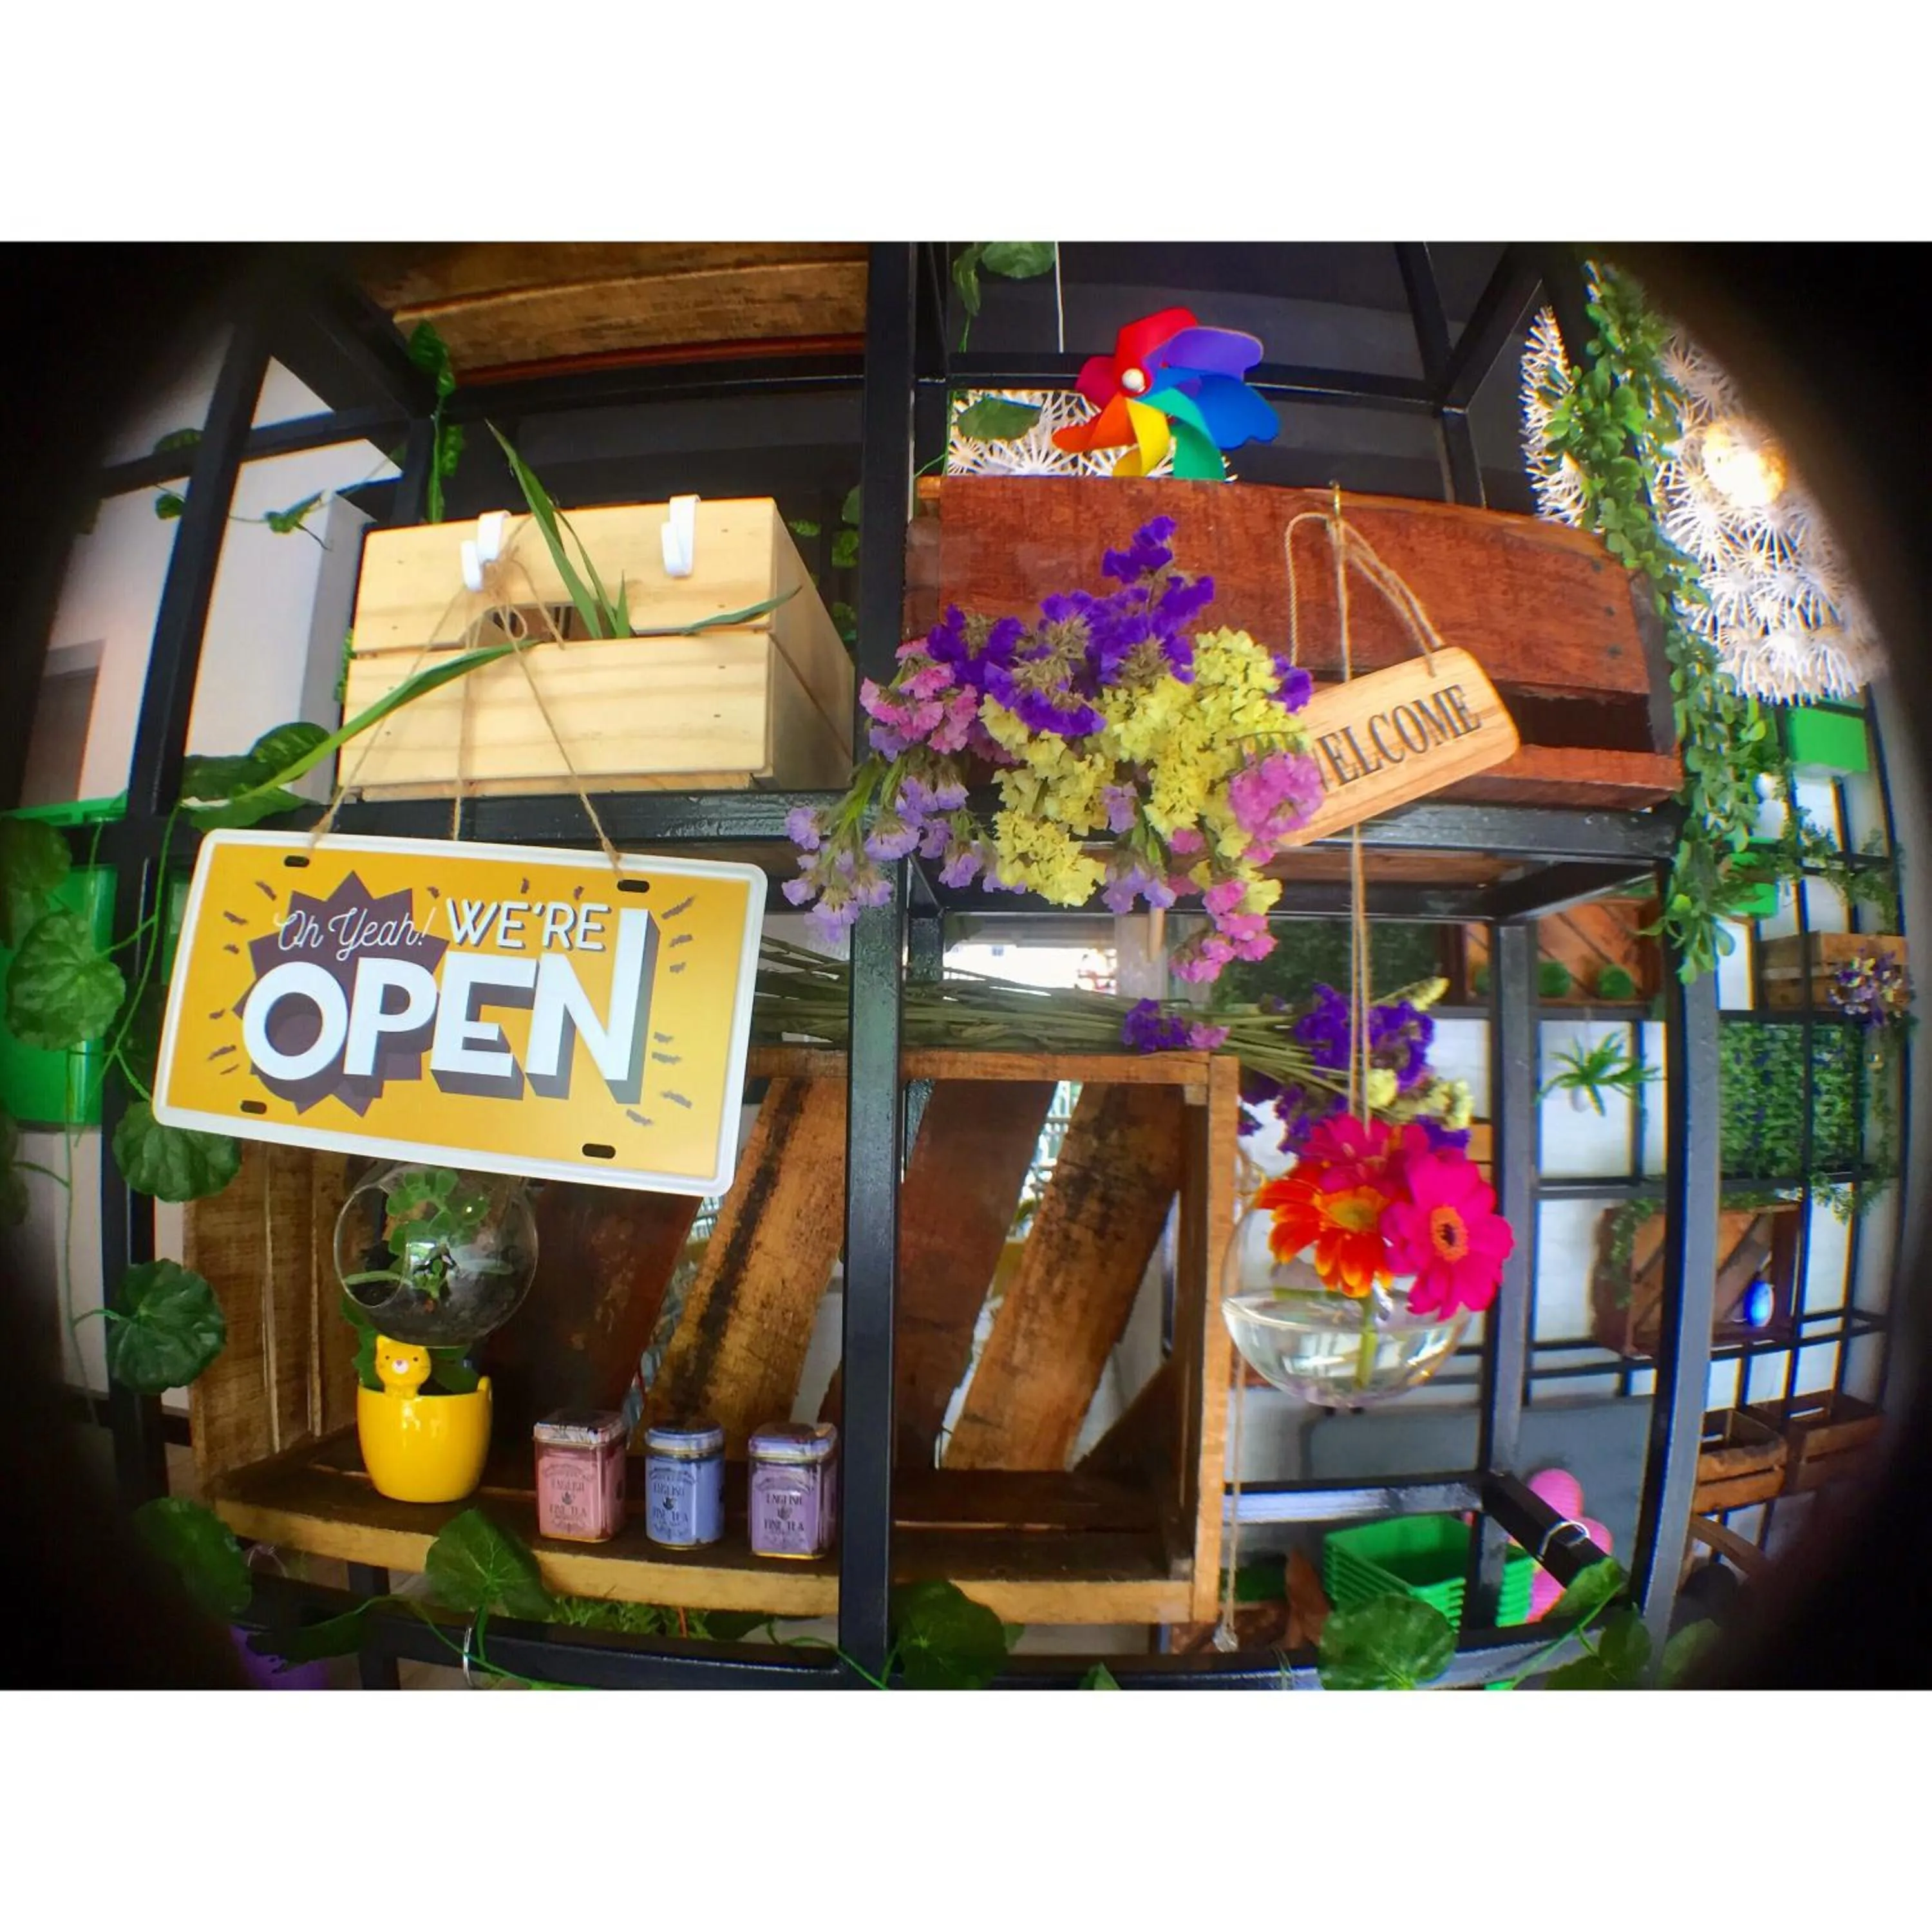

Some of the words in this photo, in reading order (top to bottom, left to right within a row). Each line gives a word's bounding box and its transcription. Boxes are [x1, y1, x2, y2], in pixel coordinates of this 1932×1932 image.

[1311, 683, 1482, 792] ELCOME
[273, 910, 324, 951] Oh
[328, 907, 437, 961] Yeah!
[446, 898, 612, 952] WE'RE
[242, 908, 652, 1088] OPEN
